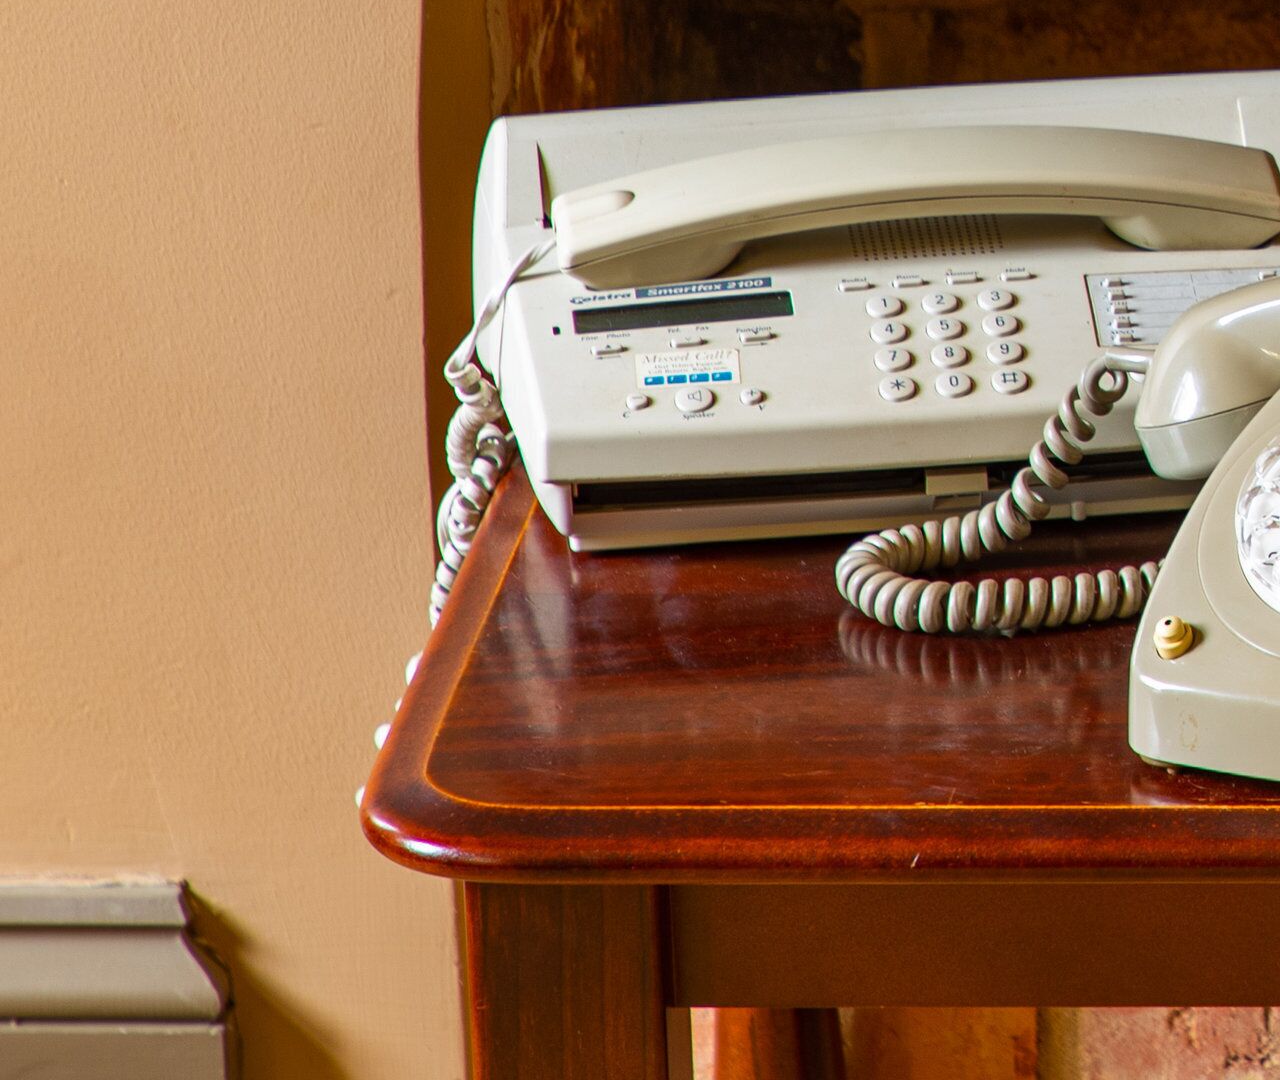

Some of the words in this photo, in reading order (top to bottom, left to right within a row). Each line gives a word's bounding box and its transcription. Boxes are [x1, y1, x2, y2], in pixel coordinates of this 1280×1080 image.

[647, 283, 722, 297] Smartfax
[727, 279, 764, 289] 2100
[935, 294, 945, 305] 2
[990, 291, 1000, 301] 3
[881, 298, 887, 308] 1
[939, 319, 949, 330] 5
[995, 316, 1005, 327] 6
[885, 323, 893, 334] 4
[944, 346, 954, 358] 8
[1000, 343, 1009, 354] 9
[888, 350, 897, 361] 7
[950, 375, 959, 387] 0
